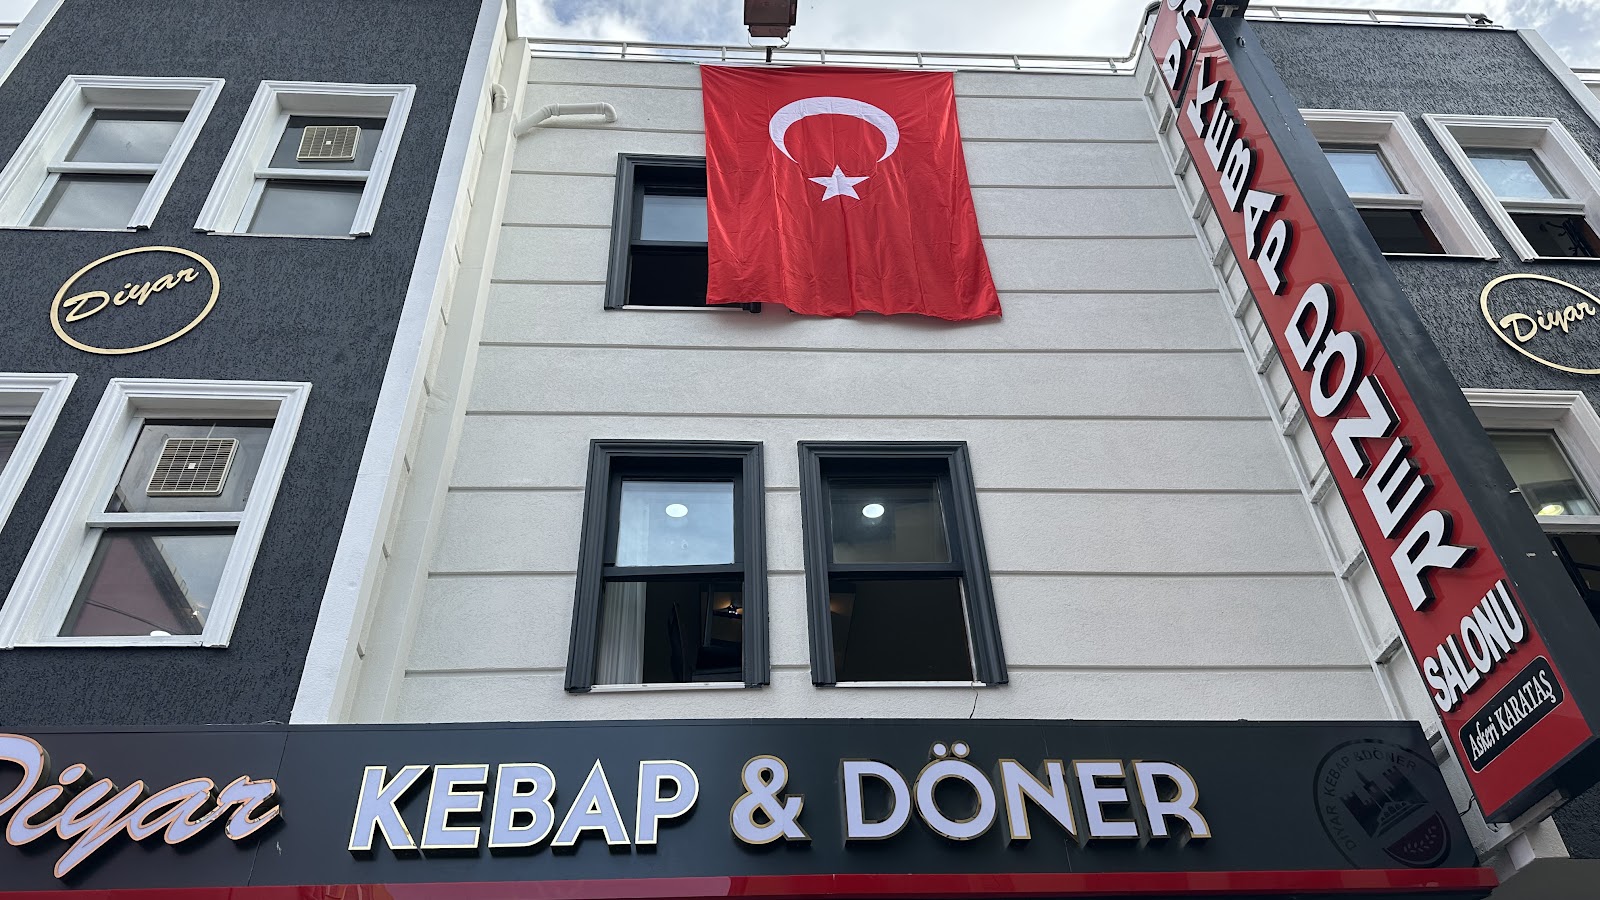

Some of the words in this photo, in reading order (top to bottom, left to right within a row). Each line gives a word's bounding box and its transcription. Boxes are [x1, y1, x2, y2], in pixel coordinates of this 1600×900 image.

[63, 267, 200, 323] Diyar
[1187, 57, 1289, 295] KEBAP
[1285, 283, 1471, 612] DÖNER
[1499, 301, 1596, 343] Diyar
[1423, 579, 1526, 713] SALONU
[1468, 715, 1501, 762] Askeri
[1493, 669, 1557, 737] KARATAŞ
[347, 758, 700, 850] KEBAP
[729, 754, 812, 846] &
[841, 740, 1213, 843] DÖNER
[1323, 756, 1351, 798] KEBAP
